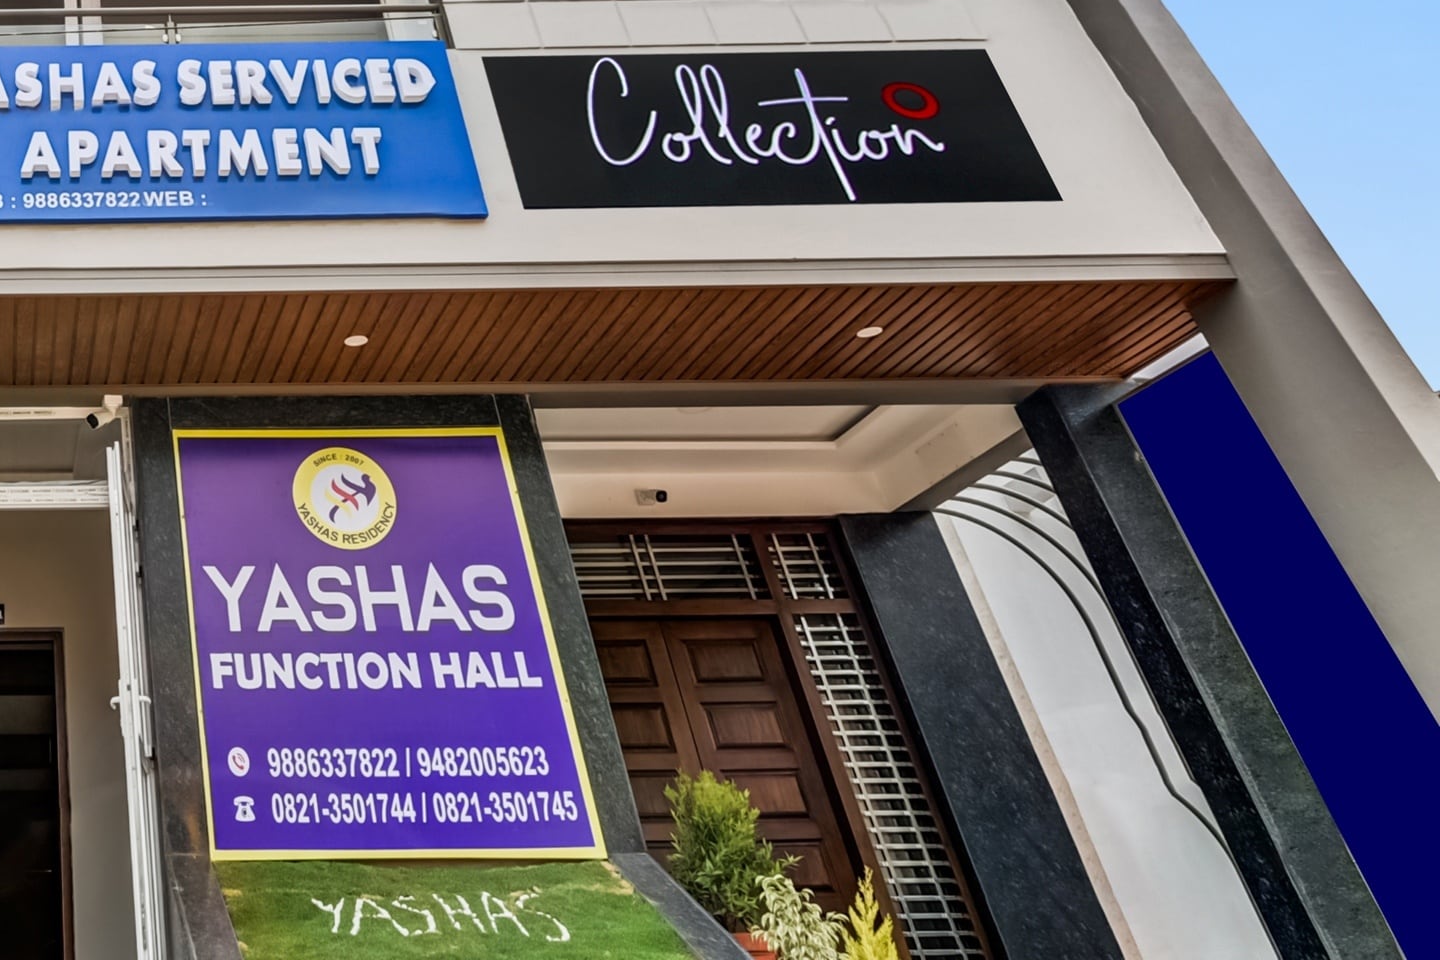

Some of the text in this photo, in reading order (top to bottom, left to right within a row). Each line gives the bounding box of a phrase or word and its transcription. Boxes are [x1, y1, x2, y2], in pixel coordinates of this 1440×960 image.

[177, 58, 436, 106] SERVICED
[587, 56, 945, 201] Collection
[20, 127, 381, 179] APARTMENT
[22, 192, 141, 209] 9886337822
[144, 191, 195, 207] WEB
[313, 453, 337, 467] SINCE
[297, 501, 395, 545] YASHAS RESIDENCY
[202, 561, 516, 633] YASHAS
[209, 650, 543, 690] FUNCTION HALL
[267, 747, 400, 778] 9886337822
[416, 746, 550, 777] 9482005623
[271, 793, 417, 824] 0821-3501744
[432, 790, 579, 823] 0821-3501745
[310, 890, 572, 943] YASHAS
